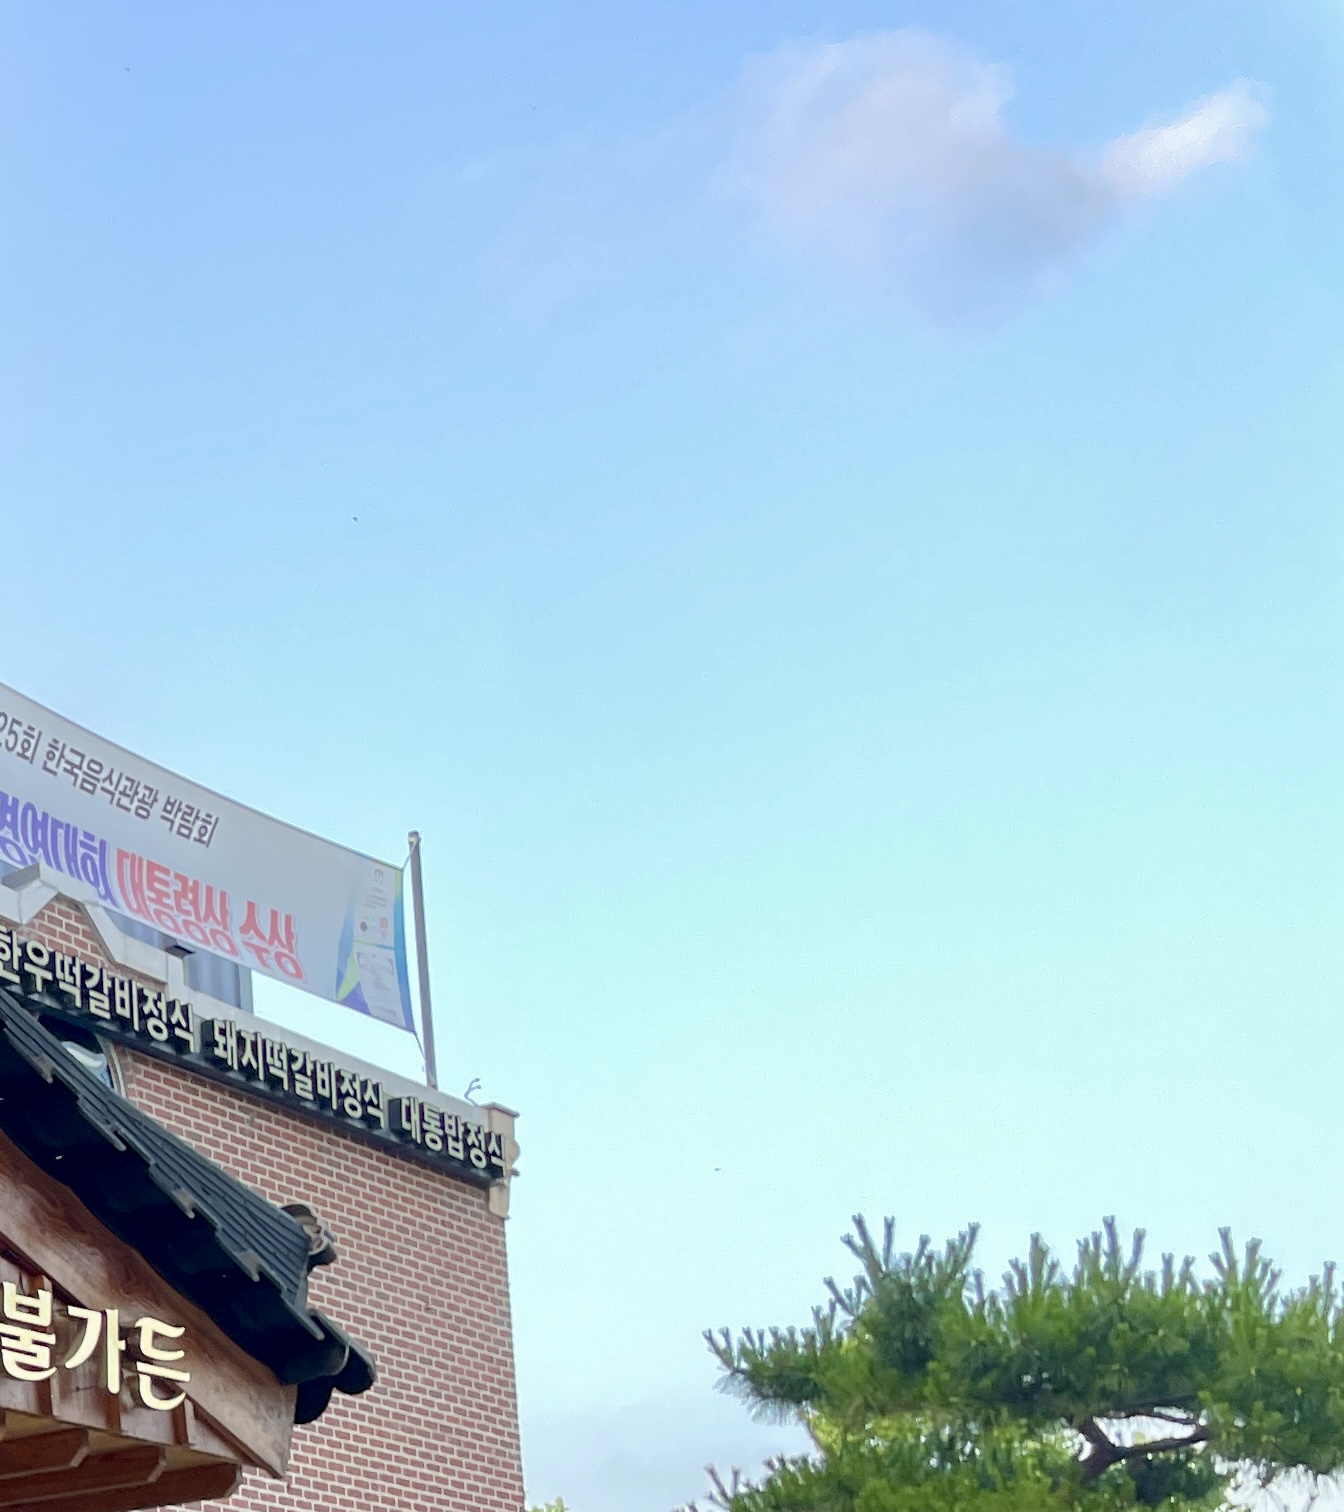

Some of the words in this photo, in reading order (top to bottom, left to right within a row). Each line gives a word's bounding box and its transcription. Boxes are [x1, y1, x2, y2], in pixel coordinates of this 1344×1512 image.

[42, 737, 159, 820] 한국음식관광
[160, 796, 219, 848] 박람회
[117, 848, 239, 957] 대통령상
[240, 900, 304, 980] 수상
[213, 1018, 384, 1129] 돼지떡갈비정식
[401, 1096, 506, 1170] 대통밥정식
